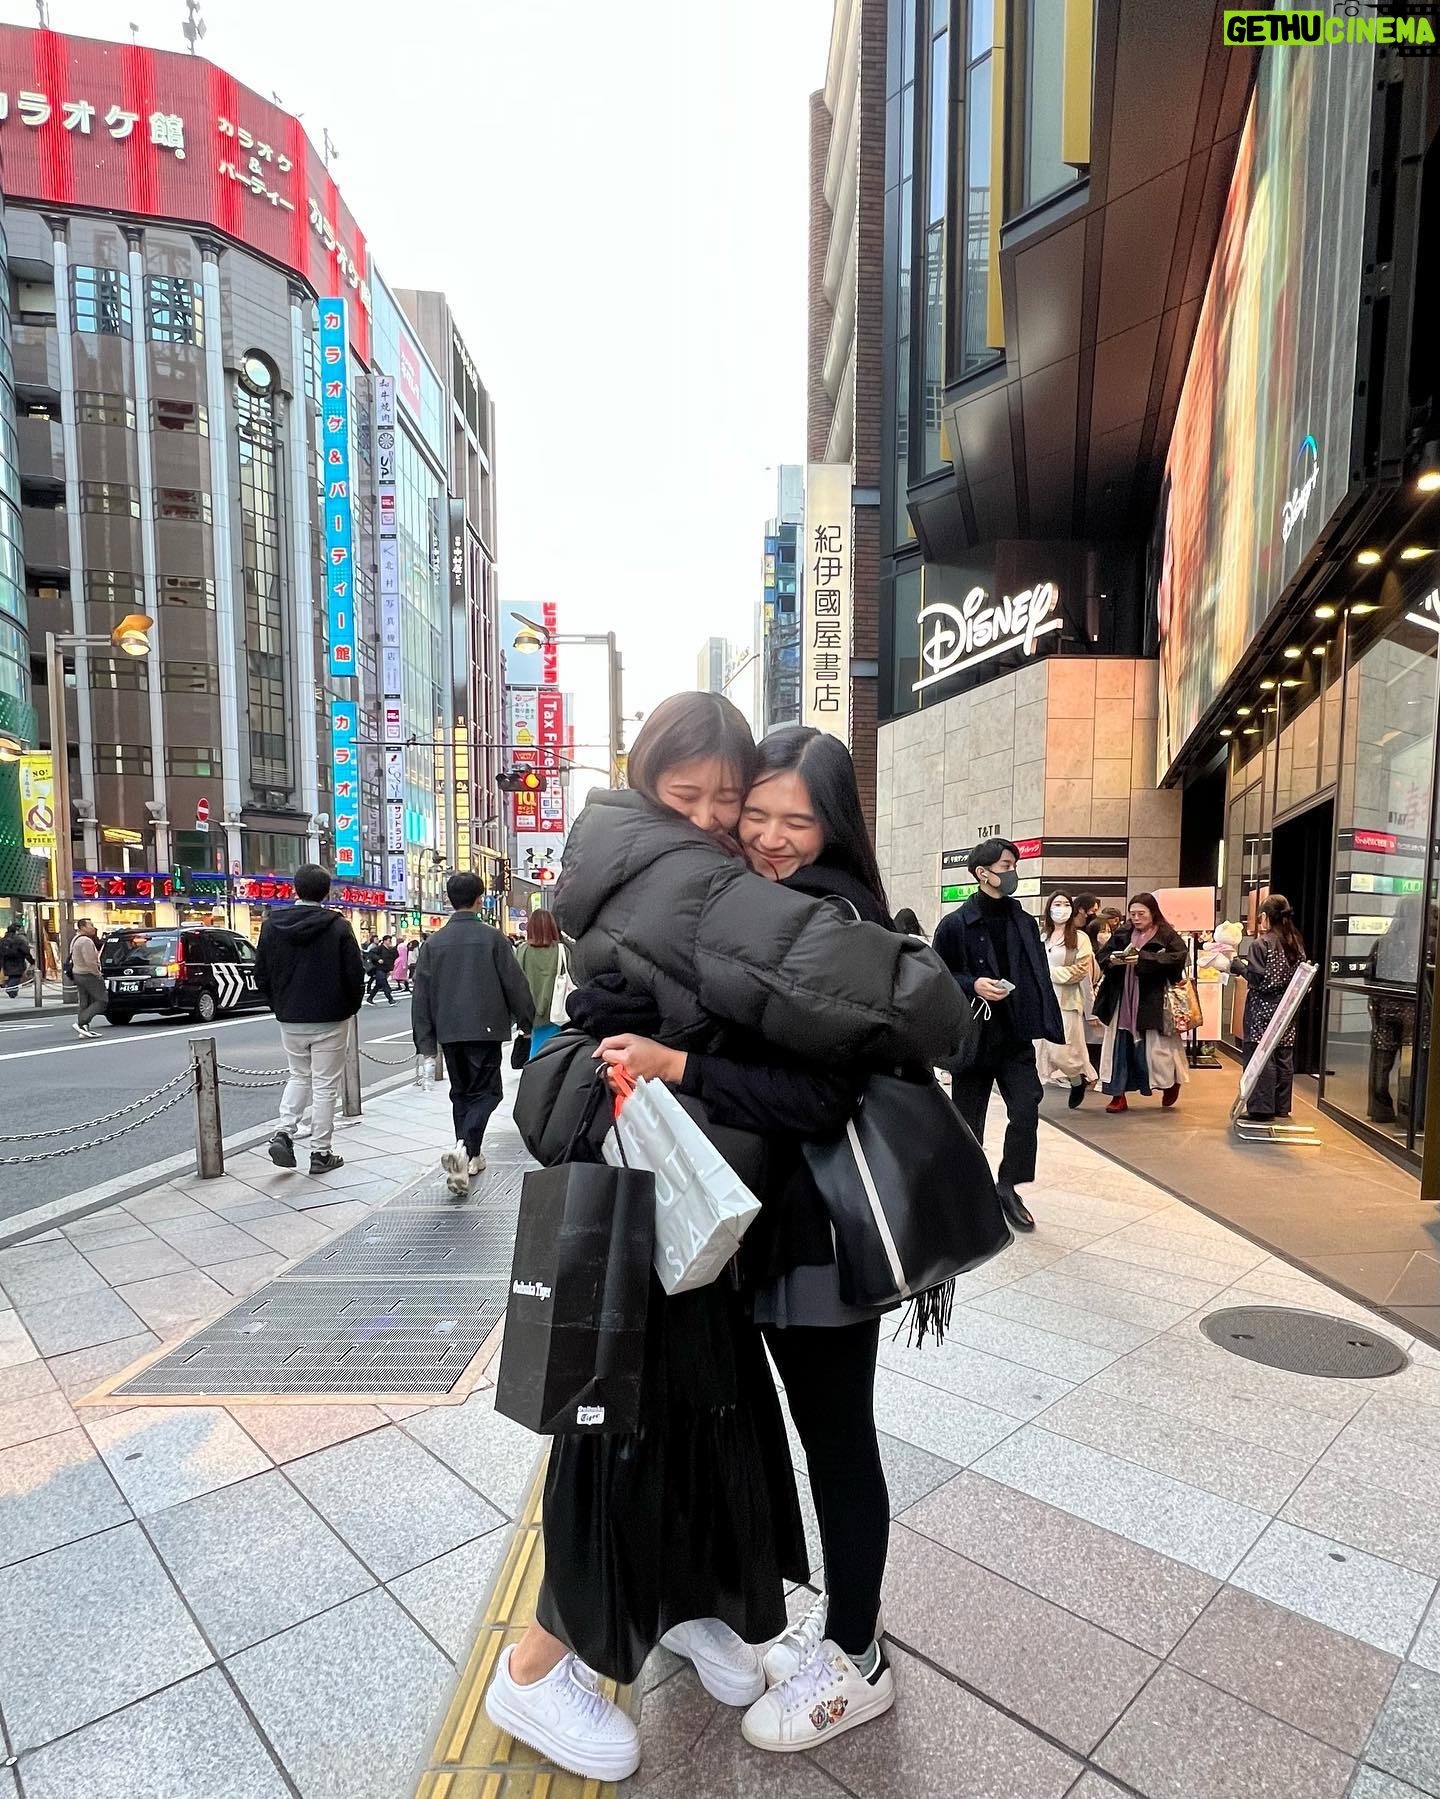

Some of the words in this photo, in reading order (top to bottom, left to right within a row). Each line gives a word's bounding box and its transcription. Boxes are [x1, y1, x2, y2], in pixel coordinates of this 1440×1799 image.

[217, 116, 294, 172] カラオケ
[248, 157, 264, 177] &
[813, 524, 843, 712] 紀伊國屋書店
[543, 701, 558, 729] Tax
[335, 715, 354, 864] カラオケ館
[246, 882, 297, 899] カラオ
